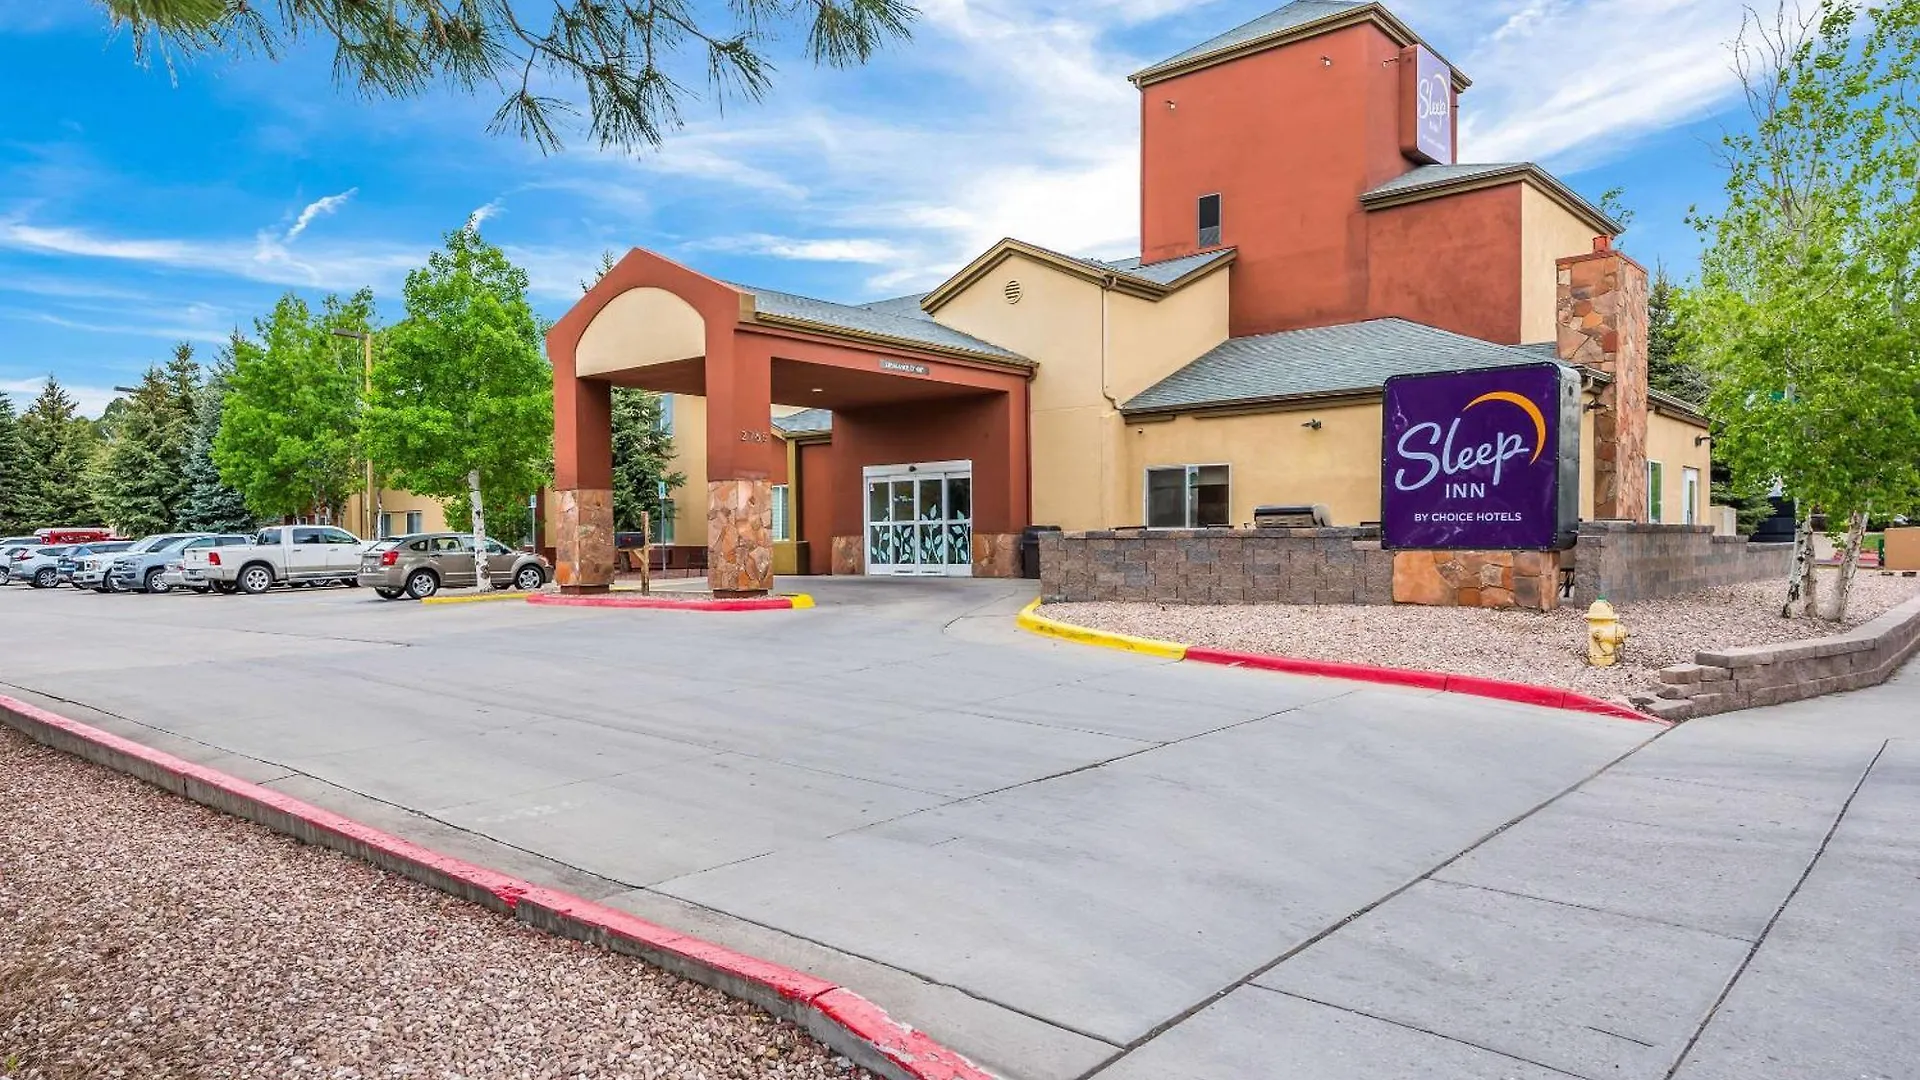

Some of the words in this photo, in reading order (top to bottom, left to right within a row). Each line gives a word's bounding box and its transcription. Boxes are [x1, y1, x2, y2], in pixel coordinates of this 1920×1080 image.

[1419, 79, 1447, 128] Sleep
[1394, 417, 1530, 491] Sleep
[1445, 483, 1485, 499] INN
[1414, 513, 1428, 521] BY
[1432, 512, 1473, 521] CHOICE
[1476, 512, 1522, 521] HOTELS
